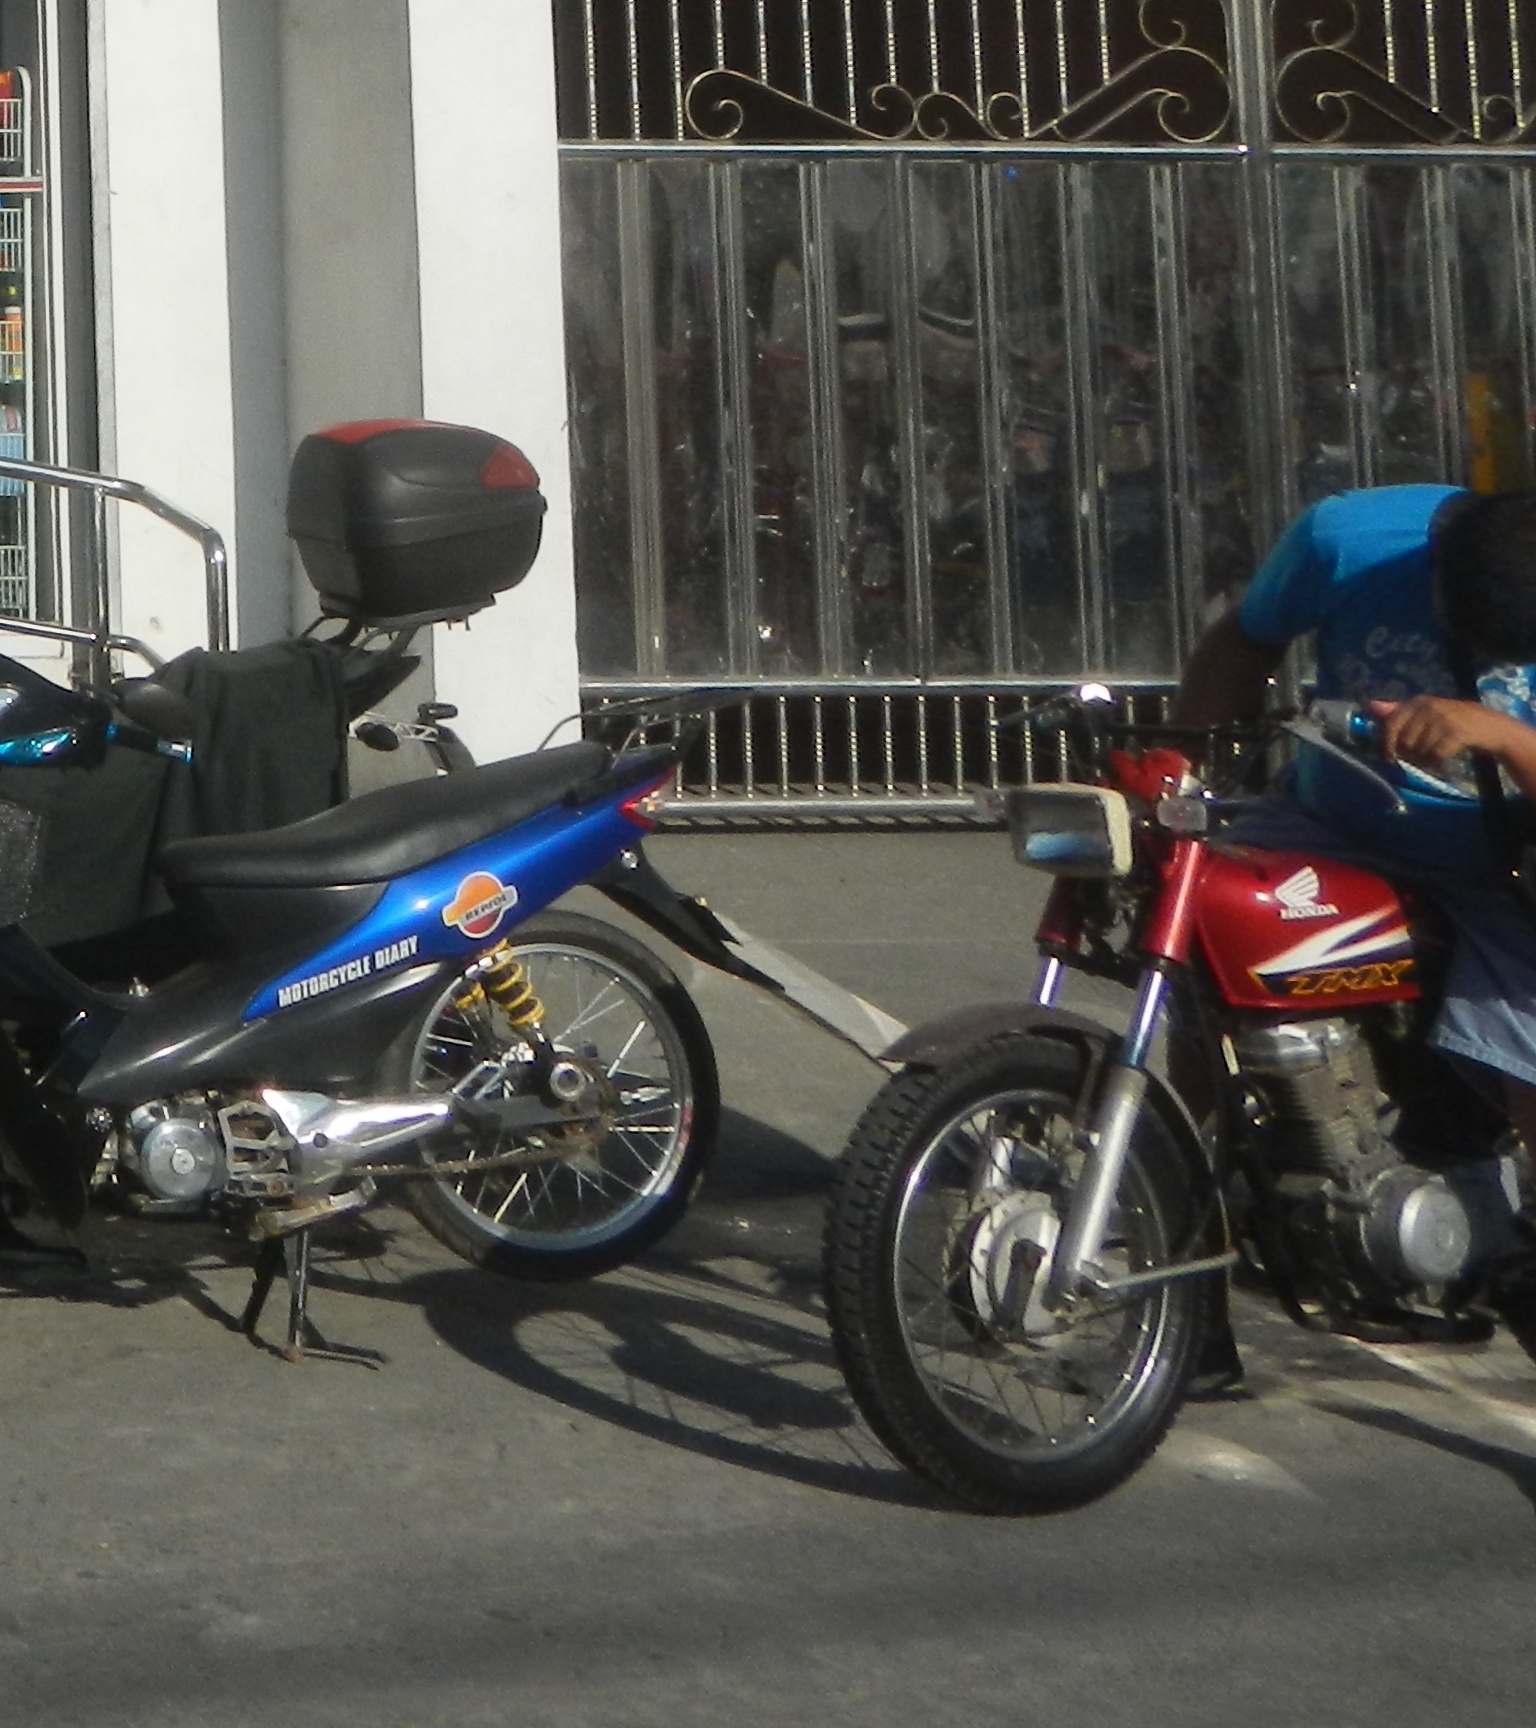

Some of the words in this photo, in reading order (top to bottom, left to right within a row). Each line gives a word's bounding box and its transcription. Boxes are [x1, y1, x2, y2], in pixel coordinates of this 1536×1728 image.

[1279, 903, 1340, 921] HONDA
[277, 955, 372, 1008] MOTORCYCLE
[374, 934, 420, 971] DIARY
